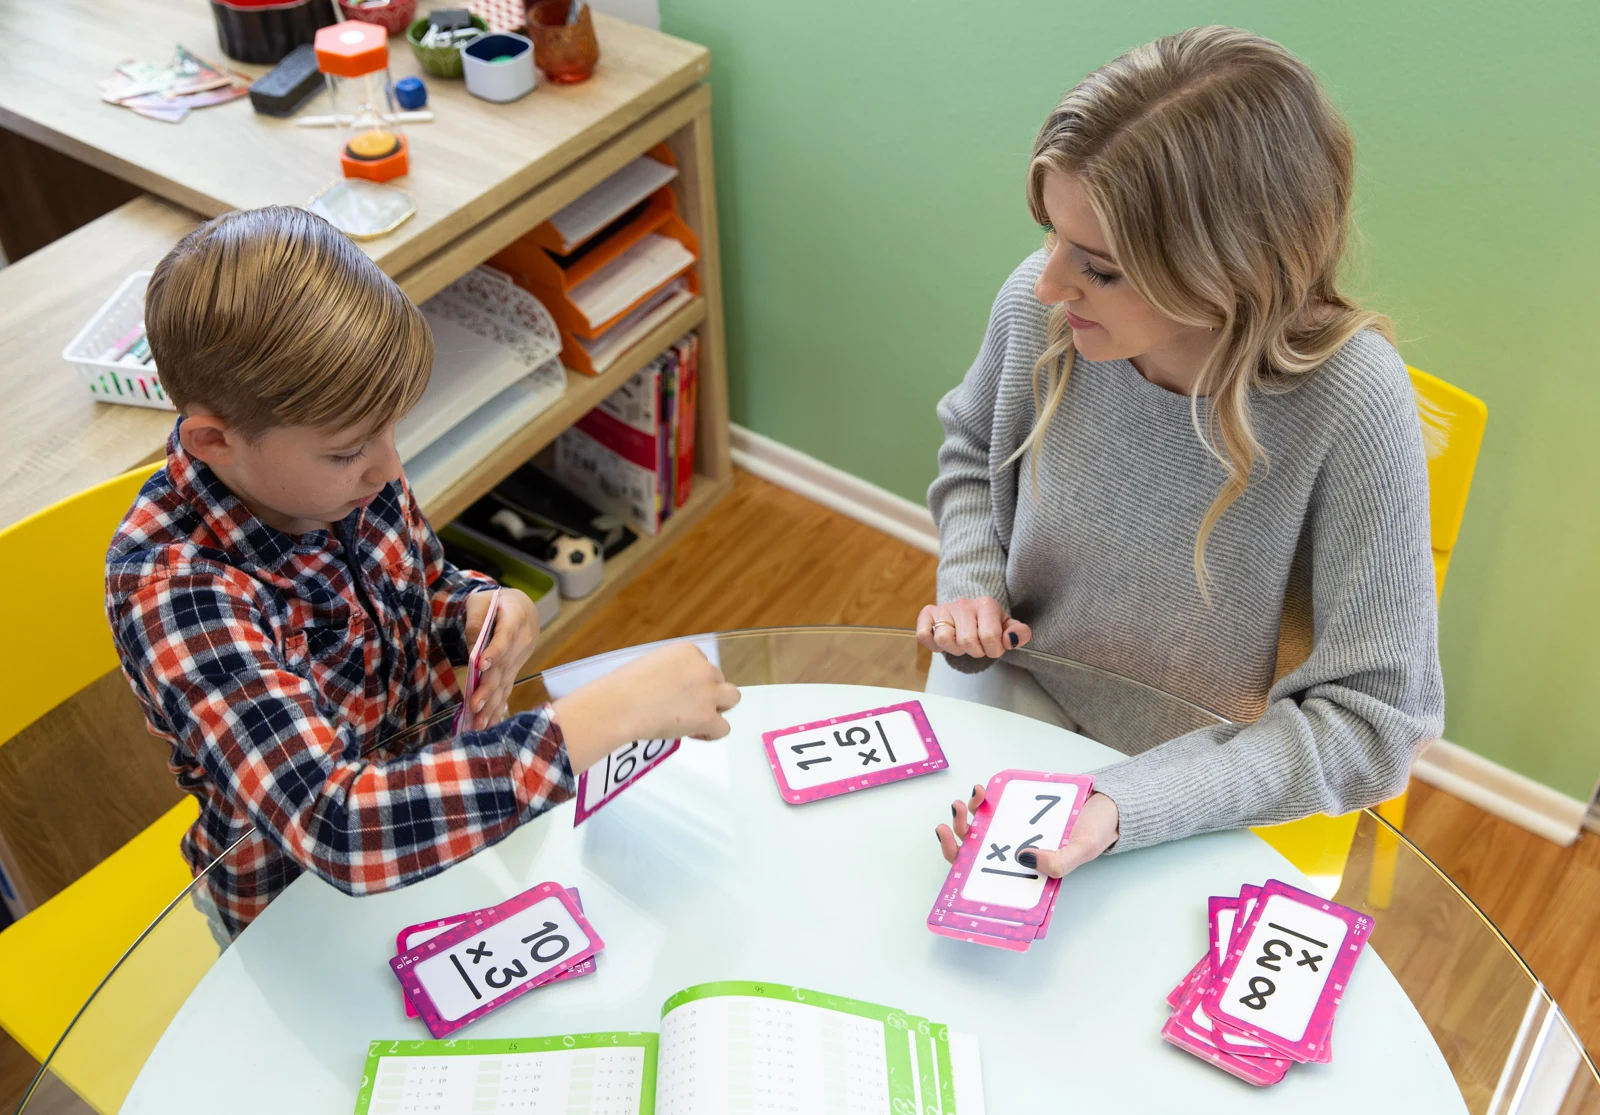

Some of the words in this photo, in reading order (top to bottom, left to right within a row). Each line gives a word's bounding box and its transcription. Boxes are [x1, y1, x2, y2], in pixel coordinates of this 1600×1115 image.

[833, 727, 870, 747] 5
[791, 740, 832, 770] 11
[1029, 795, 1061, 825] 7
[521, 922, 569, 963] 10
[1256, 939, 1292, 972] 3
[485, 959, 528, 989] 3
[1239, 977, 1275, 1010] 8
[508, 1042, 518, 1051] 57
